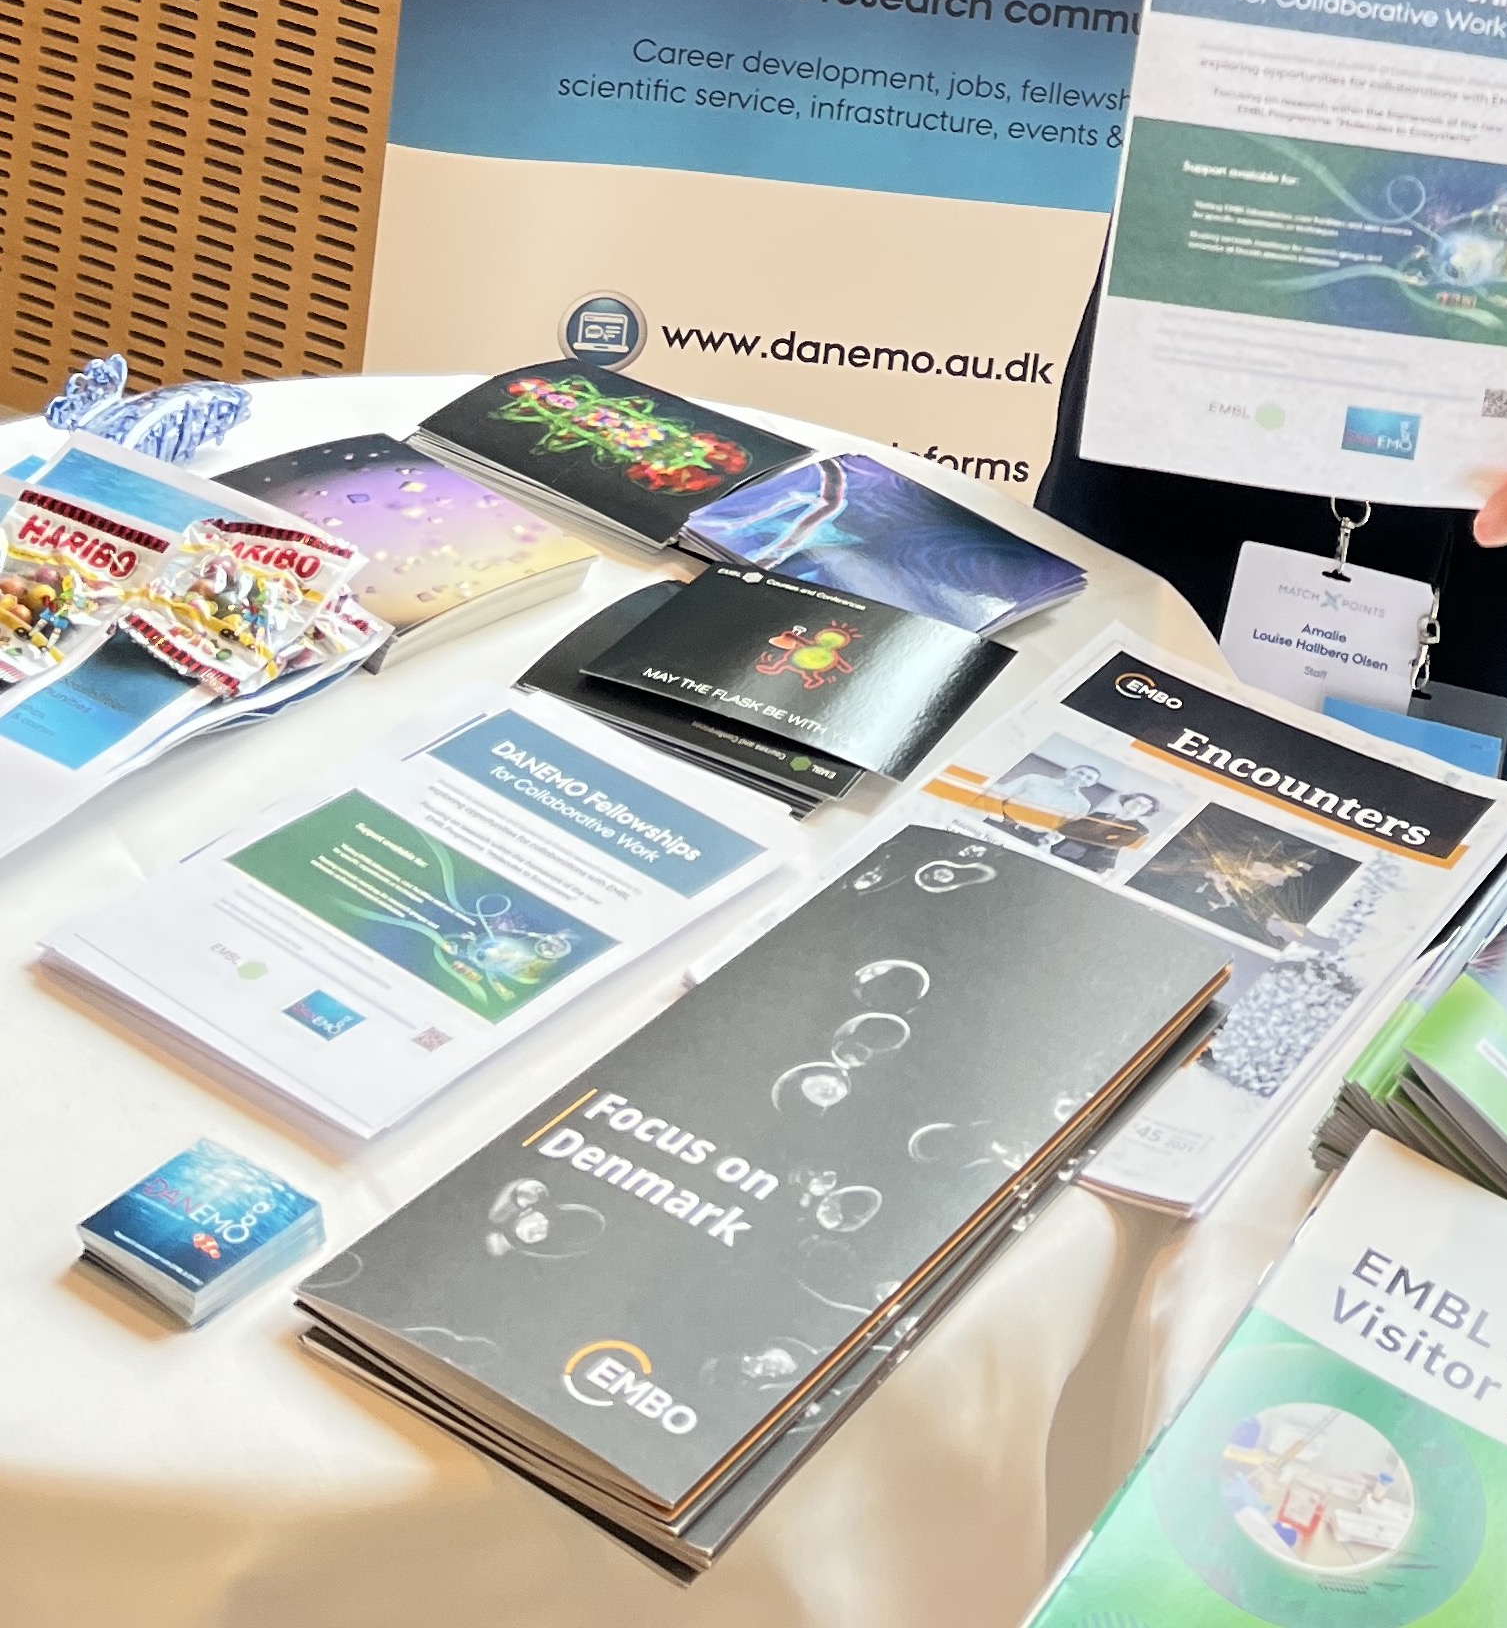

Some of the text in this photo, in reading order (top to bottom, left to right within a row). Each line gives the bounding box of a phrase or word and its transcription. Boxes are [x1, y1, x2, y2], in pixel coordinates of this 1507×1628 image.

[1444, 9, 1507, 39] Work
[633, 38, 734, 74] Career
[743, 48, 940, 97] development,
[946, 69, 1011, 105] jobs,
[558, 74, 1123, 149] scientific service, infrastructure, events &
[661, 325, 1053, 385] www.danemo.au.dk
[1208, 401, 1250, 420] EMBL
[17, 514, 138, 579] HARIBO
[1278, 583, 1385, 618] MATCH POINTS
[1301, 623, 1347, 644] Amalie
[1253, 628, 1388, 671] Louise Hallberg Olsen
[1304, 665, 1328, 679] Staff
[641, 667, 829, 735] MAY THE FLASK BE WITH
[1127, 679, 1183, 710] EMBO
[489, 764, 660, 864] for Collaborative Work
[491, 740, 588, 798] DANEMO
[583, 789, 702, 862] Fellowships
[1166, 727, 1431, 846] Encounters
[583, 1093, 779, 1201] Focus on
[142, 1177, 250, 1244] DANEMO
[538, 1127, 752, 1247] Denmark
[1352, 1247, 1494, 1348] EMBL
[1334, 1286, 1502, 1403] Visitor
[586, 1357, 698, 1434] EMBO
